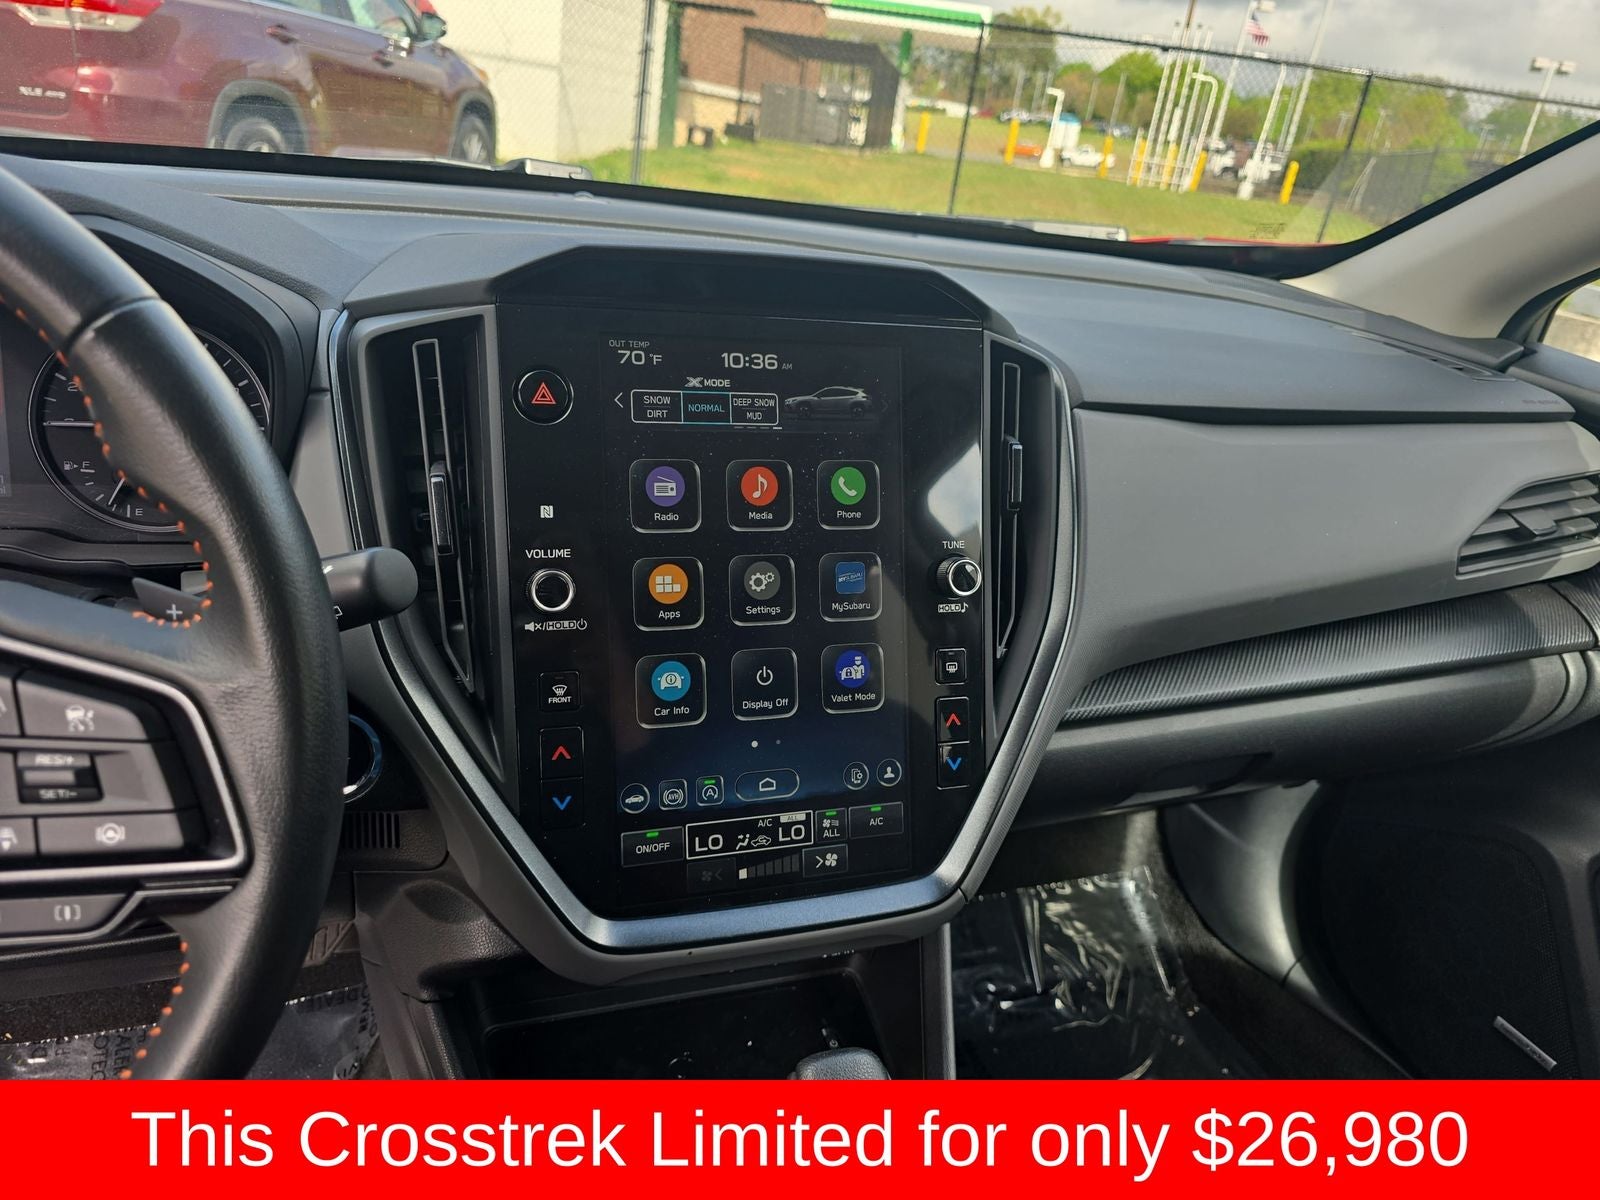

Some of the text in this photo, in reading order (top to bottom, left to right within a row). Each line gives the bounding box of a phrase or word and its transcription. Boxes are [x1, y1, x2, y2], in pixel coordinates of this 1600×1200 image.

[608, 339, 651, 348] OUT TEMP
[617, 349, 646, 366] 70
[721, 351, 793, 371] 10:36 AM
[642, 394, 672, 406] SNOW
[732, 397, 776, 408] DEEP SNOW
[646, 408, 668, 419] DIRT
[687, 402, 726, 414] NORMAL
[746, 410, 763, 421] MUD
[82, 461, 91, 469] F
[135, 507, 144, 517] E
[653, 511, 680, 522] Radio
[748, 510, 774, 521] Media
[836, 508, 862, 520] Phone
[942, 540, 965, 549] TUNE
[525, 548, 571, 559] VOLUME
[745, 604, 781, 616] Settings
[831, 601, 871, 613] MySubaru
[938, 603, 961, 613] HOLD
[658, 609, 681, 620] Apps
[548, 696, 572, 705] FRONT
[831, 691, 876, 704] Valet Mode
[742, 697, 789, 712] Display Off
[654, 705, 690, 717] Car Info
[757, 818, 773, 828] A/C
[869, 816, 884, 827] A/C
[778, 824, 805, 842] LO
[822, 829, 840, 838] ALL
[694, 833, 724, 851] LO
[635, 842, 671, 854] ON/OFF
